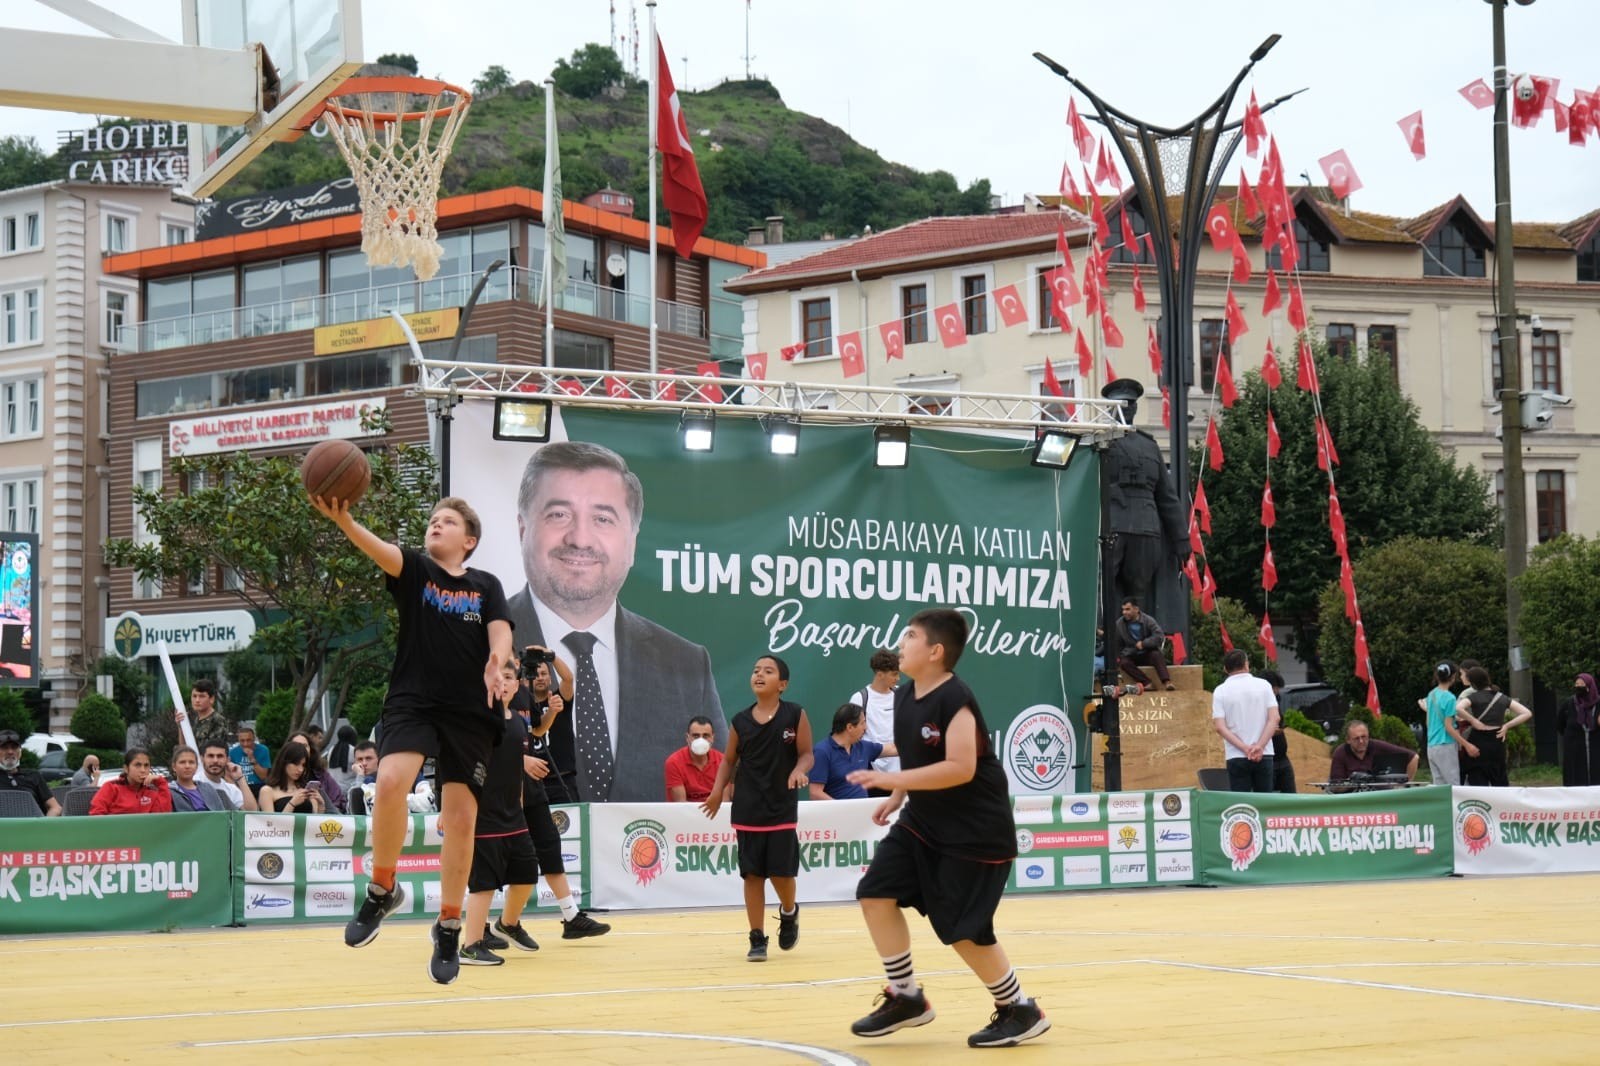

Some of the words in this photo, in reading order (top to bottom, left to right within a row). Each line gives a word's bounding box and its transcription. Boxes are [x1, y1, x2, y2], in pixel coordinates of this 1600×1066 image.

[81, 122, 187, 152] HOTEL
[331, 336, 366, 347] RESTAURANT
[256, 413, 309, 429] HAREKET
[788, 511, 964, 556] MÜSABAKAYA
[974, 525, 1071, 562] KATILAN
[656, 543, 740, 595] TÜM
[749, 553, 1071, 611] SPORCULARIMIZA
[1150, 696, 1168, 707] VE
[1266, 816, 1319, 828] GİRESUN
[1324, 813, 1396, 826] BELEDİYESİ
[1499, 811, 1557, 821] GİRESUN
[248, 828, 290, 840] yavuzkan
[1266, 827, 1325, 856] SOKAK
[1328, 824, 1435, 855] BASKETBOLU
[1499, 821, 1562, 848] SOKAK
[22, 849, 138, 865] BELEDİYESİ
[28, 860, 199, 901] BASKETBOLU
